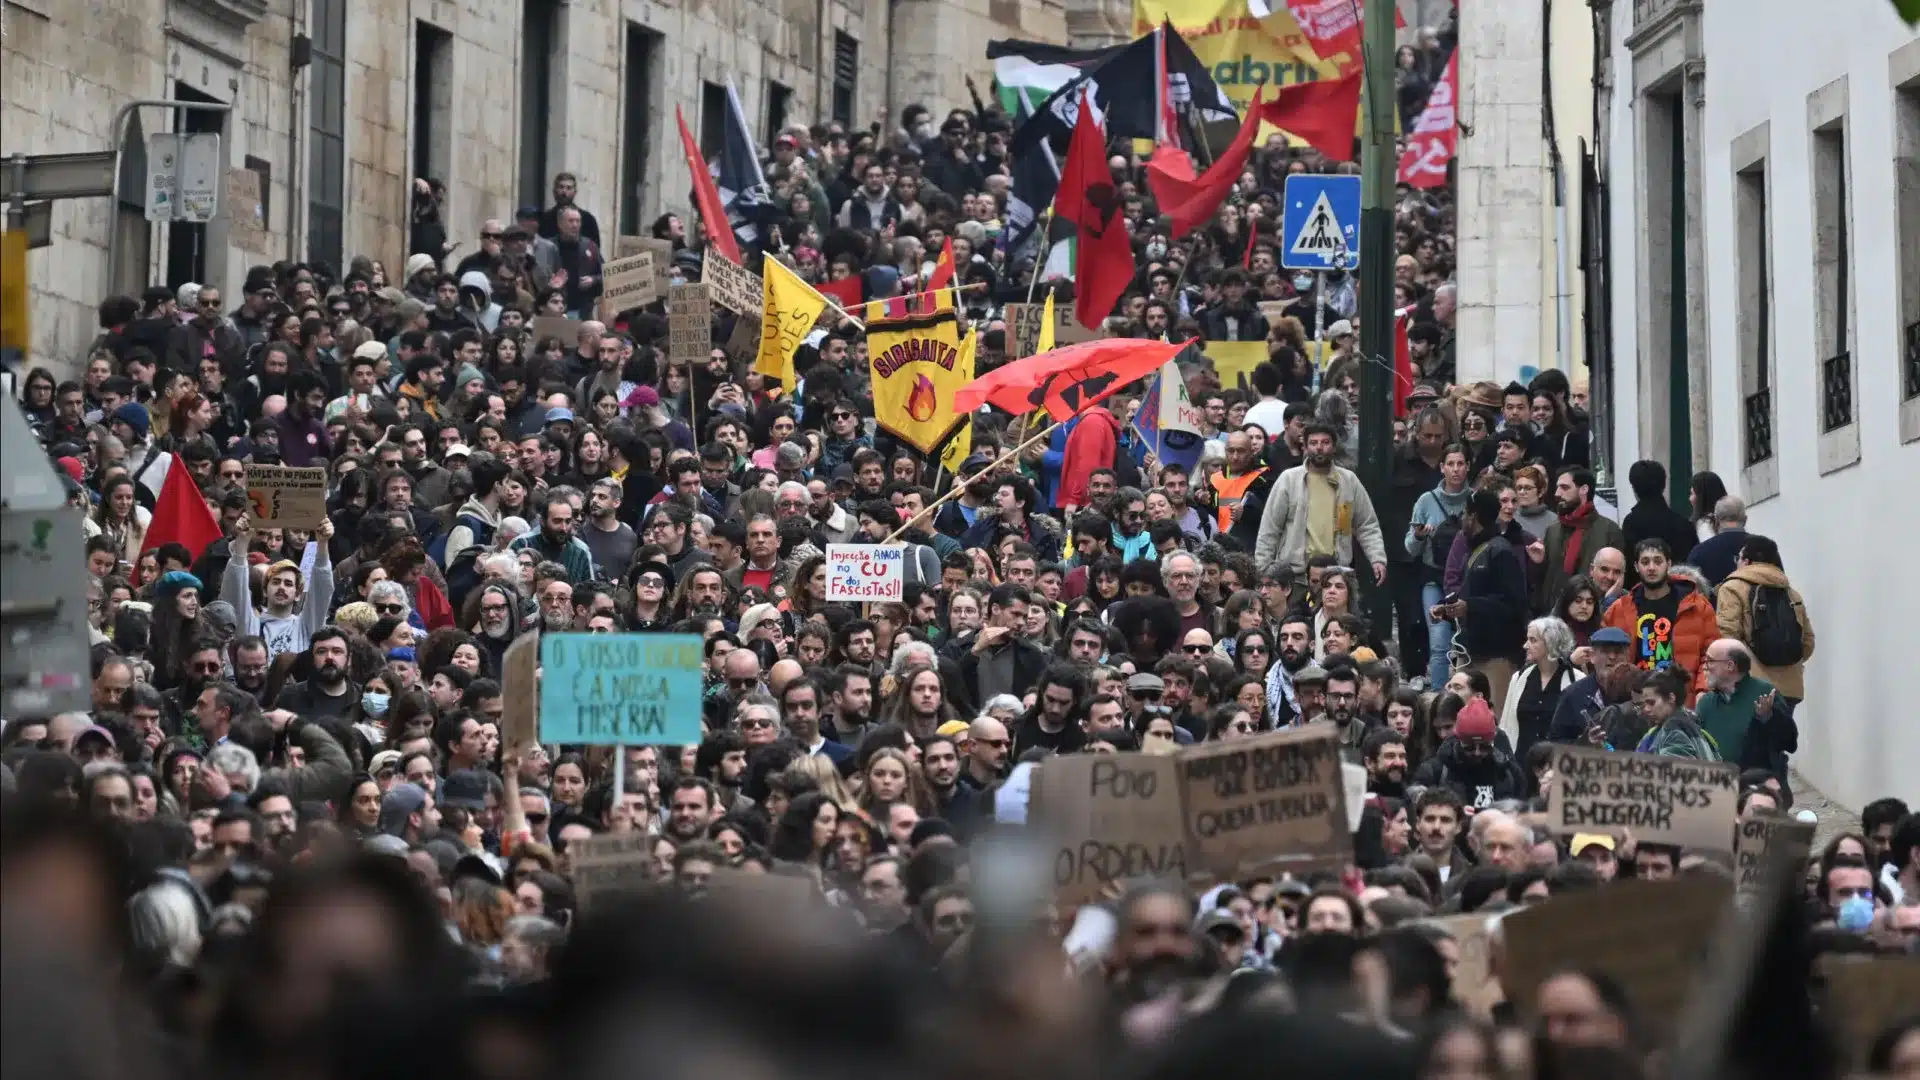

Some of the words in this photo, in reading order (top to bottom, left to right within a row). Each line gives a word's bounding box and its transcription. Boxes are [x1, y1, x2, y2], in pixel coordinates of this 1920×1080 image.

[873, 338, 958, 379] SIRIGAITA
[837, 564, 850, 573] no
[861, 561, 887, 576] CU
[1562, 777, 1602, 798] NÃO
[1563, 800, 1674, 830] EMIGRAR
